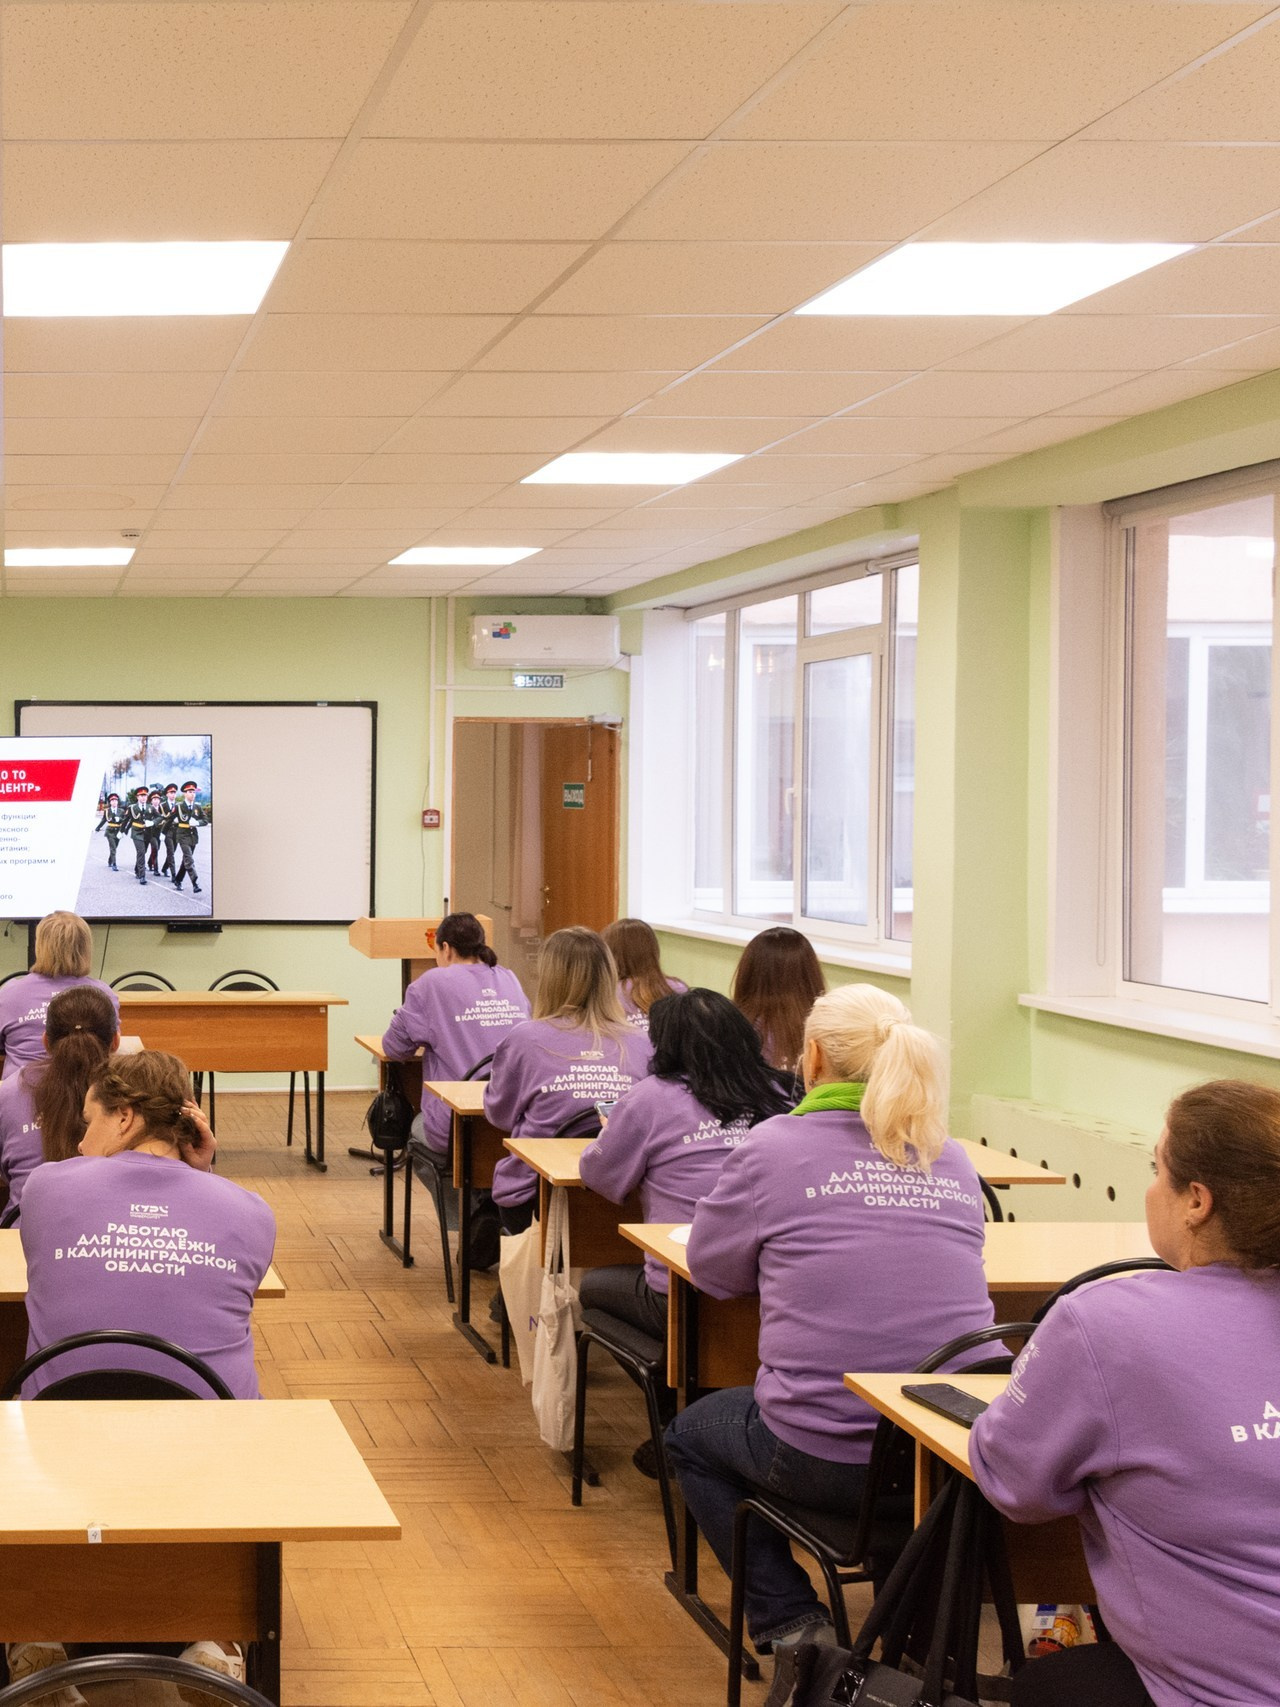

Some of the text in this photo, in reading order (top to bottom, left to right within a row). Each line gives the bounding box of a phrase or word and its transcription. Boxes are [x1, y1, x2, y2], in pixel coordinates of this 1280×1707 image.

[12, 770, 27, 780] ТО
[10, 857, 49, 865] программ
[570, 1065, 619, 1073] РАБОТАЮ
[554, 1074, 574, 1083] ДЛЯ
[572, 1091, 619, 1099] ОБЛАСТИ
[23, 1124, 29, 1133] В
[683, 1135, 691, 1144] В
[829, 1171, 961, 1190] ДЛЯ МОЛОДЁЖИ
[805, 1183, 978, 1209] В КАЛИНИНГРАДСКОЙ
[864, 1195, 941, 1211] ОБЛАСТИ
[107, 1222, 188, 1238] РАБОТАЮ
[77, 1234, 216, 1254] ДЛЯ МОЛОДЁЖИ
[55, 1247, 238, 1273] В КАЛИНИНГРАДСКОЙ
[105, 1260, 186, 1276] ОБЛАСТИ
[1231, 1425, 1248, 1442] В
